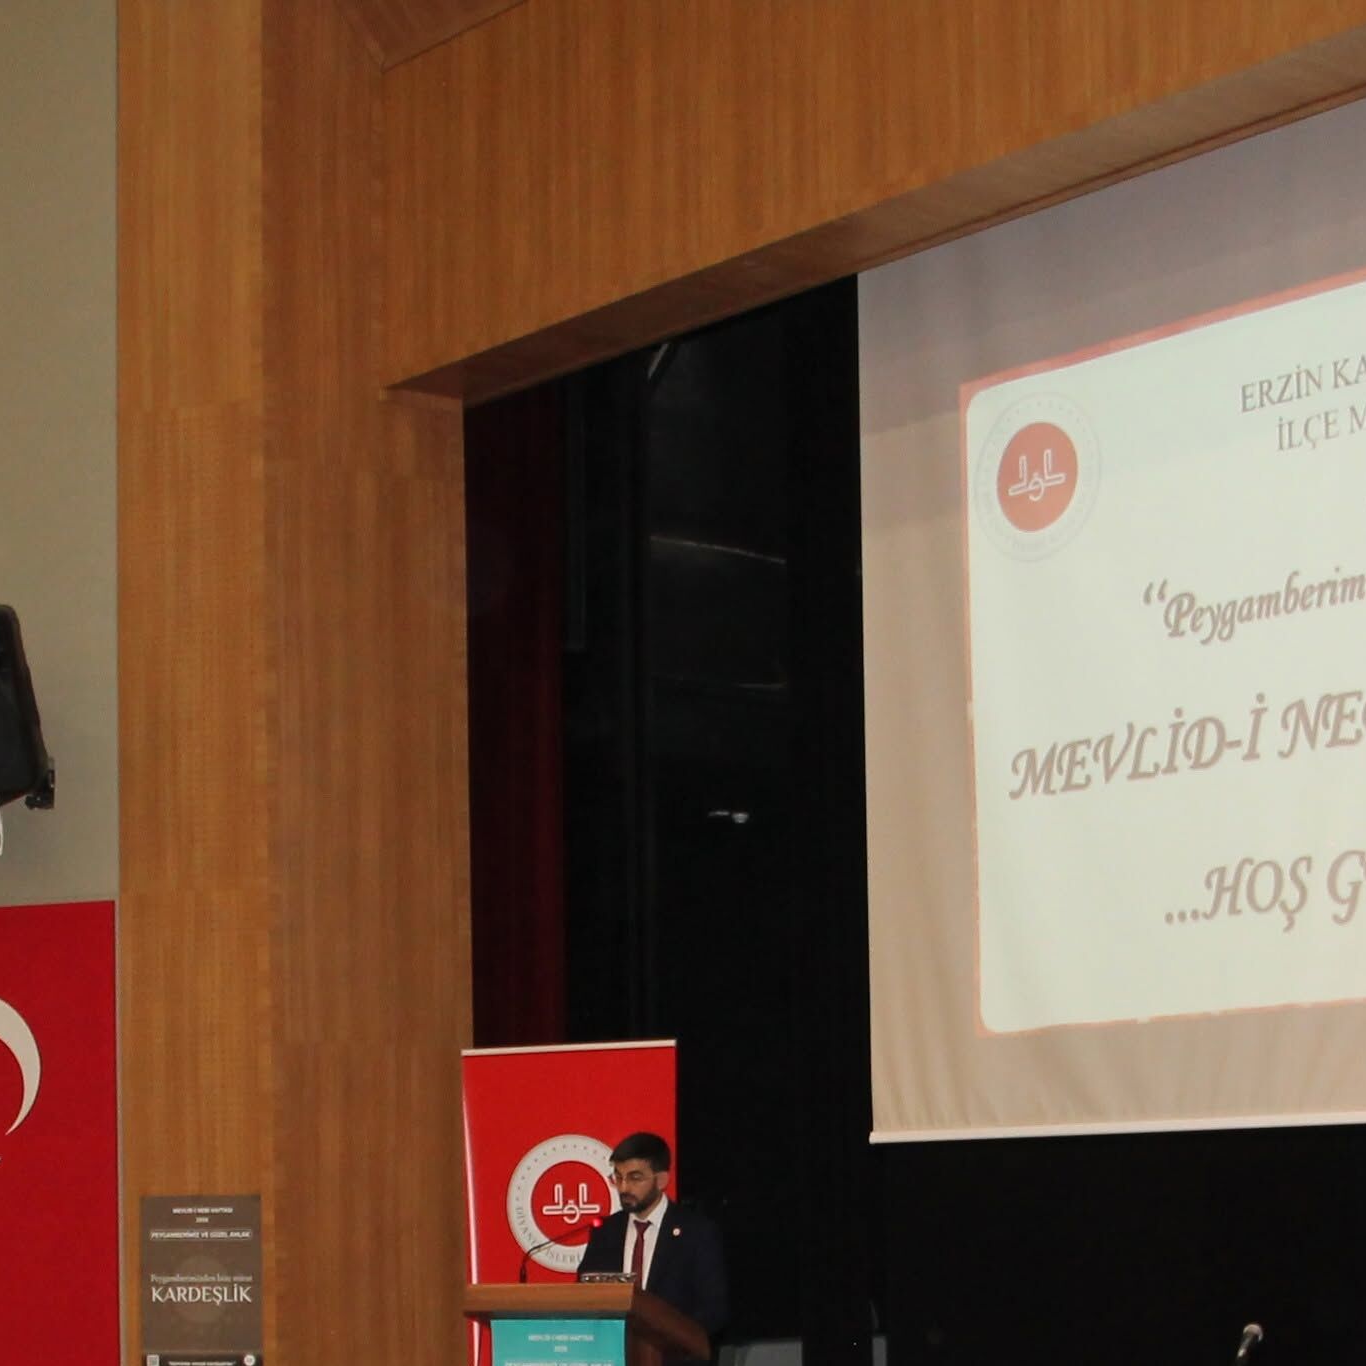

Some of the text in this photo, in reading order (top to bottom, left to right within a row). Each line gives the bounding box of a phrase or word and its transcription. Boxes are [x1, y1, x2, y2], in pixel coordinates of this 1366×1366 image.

[1240, 363, 1324, 413] ERZİN
[1277, 409, 1340, 451] İLÇE
[1008, 691, 1269, 801] MEVLİD-İ
[151, 1283, 252, 1306] KARDEŞLİK
